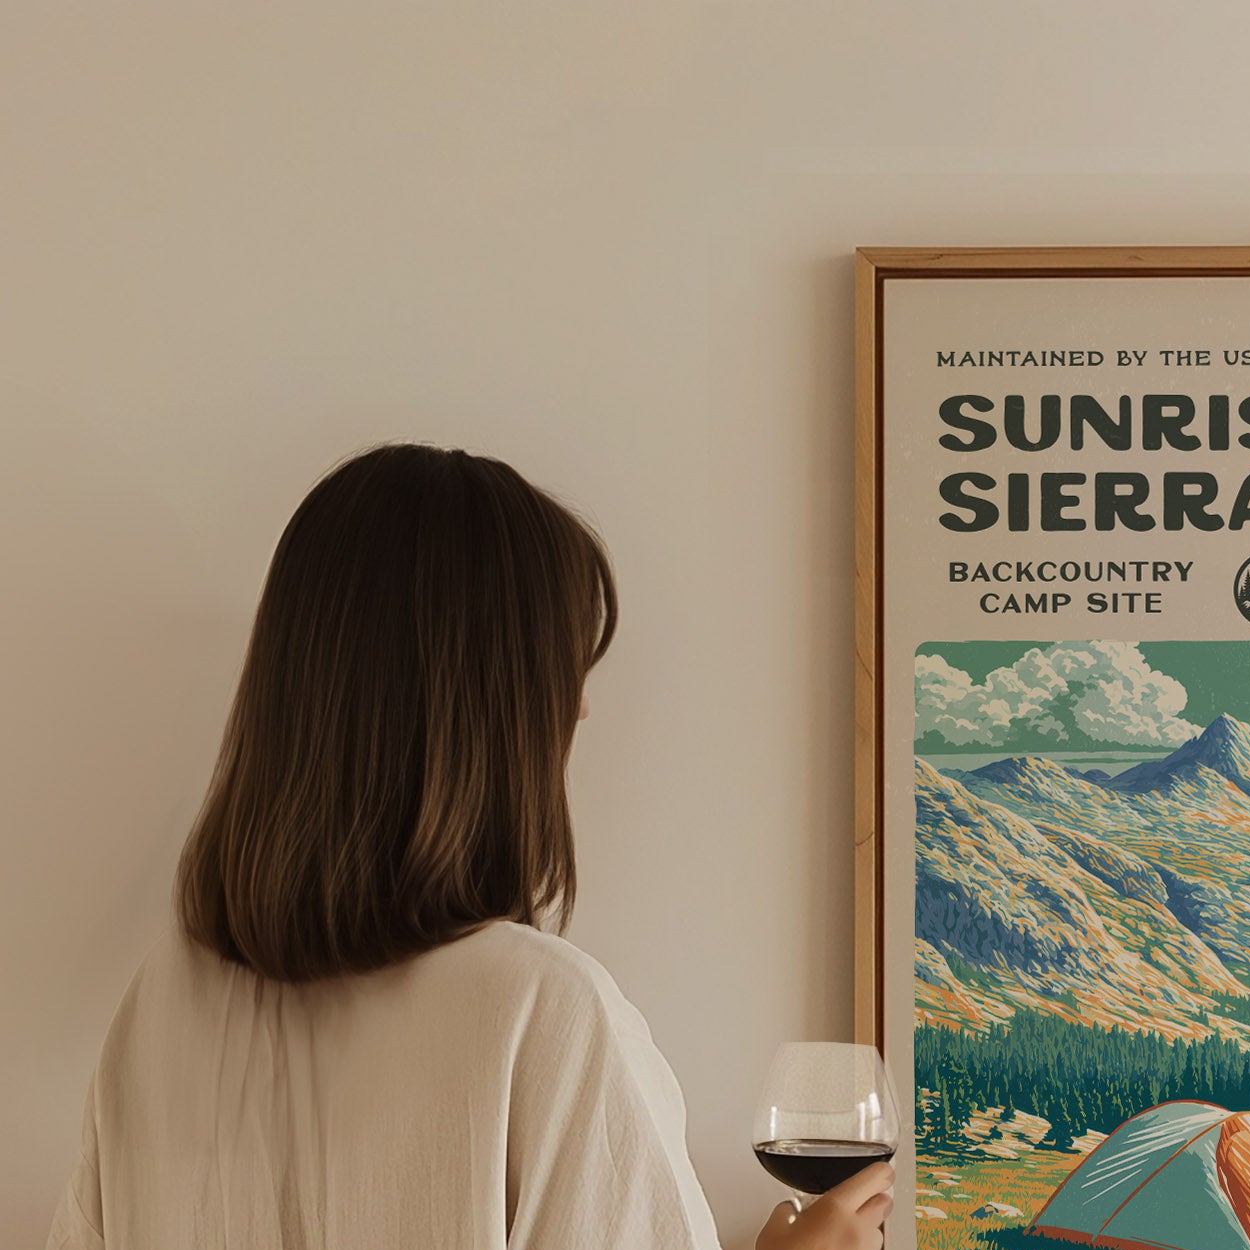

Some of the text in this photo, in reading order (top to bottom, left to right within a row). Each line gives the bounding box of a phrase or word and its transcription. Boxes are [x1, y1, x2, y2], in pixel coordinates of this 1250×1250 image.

[937, 350, 1104, 367] MAINTAINED
[1117, 350, 1148, 367] BY
[1160, 350, 1211, 367] THE
[949, 560, 1194, 583] BACKCOUNTRY
[979, 592, 1162, 614] CAMP SITE
